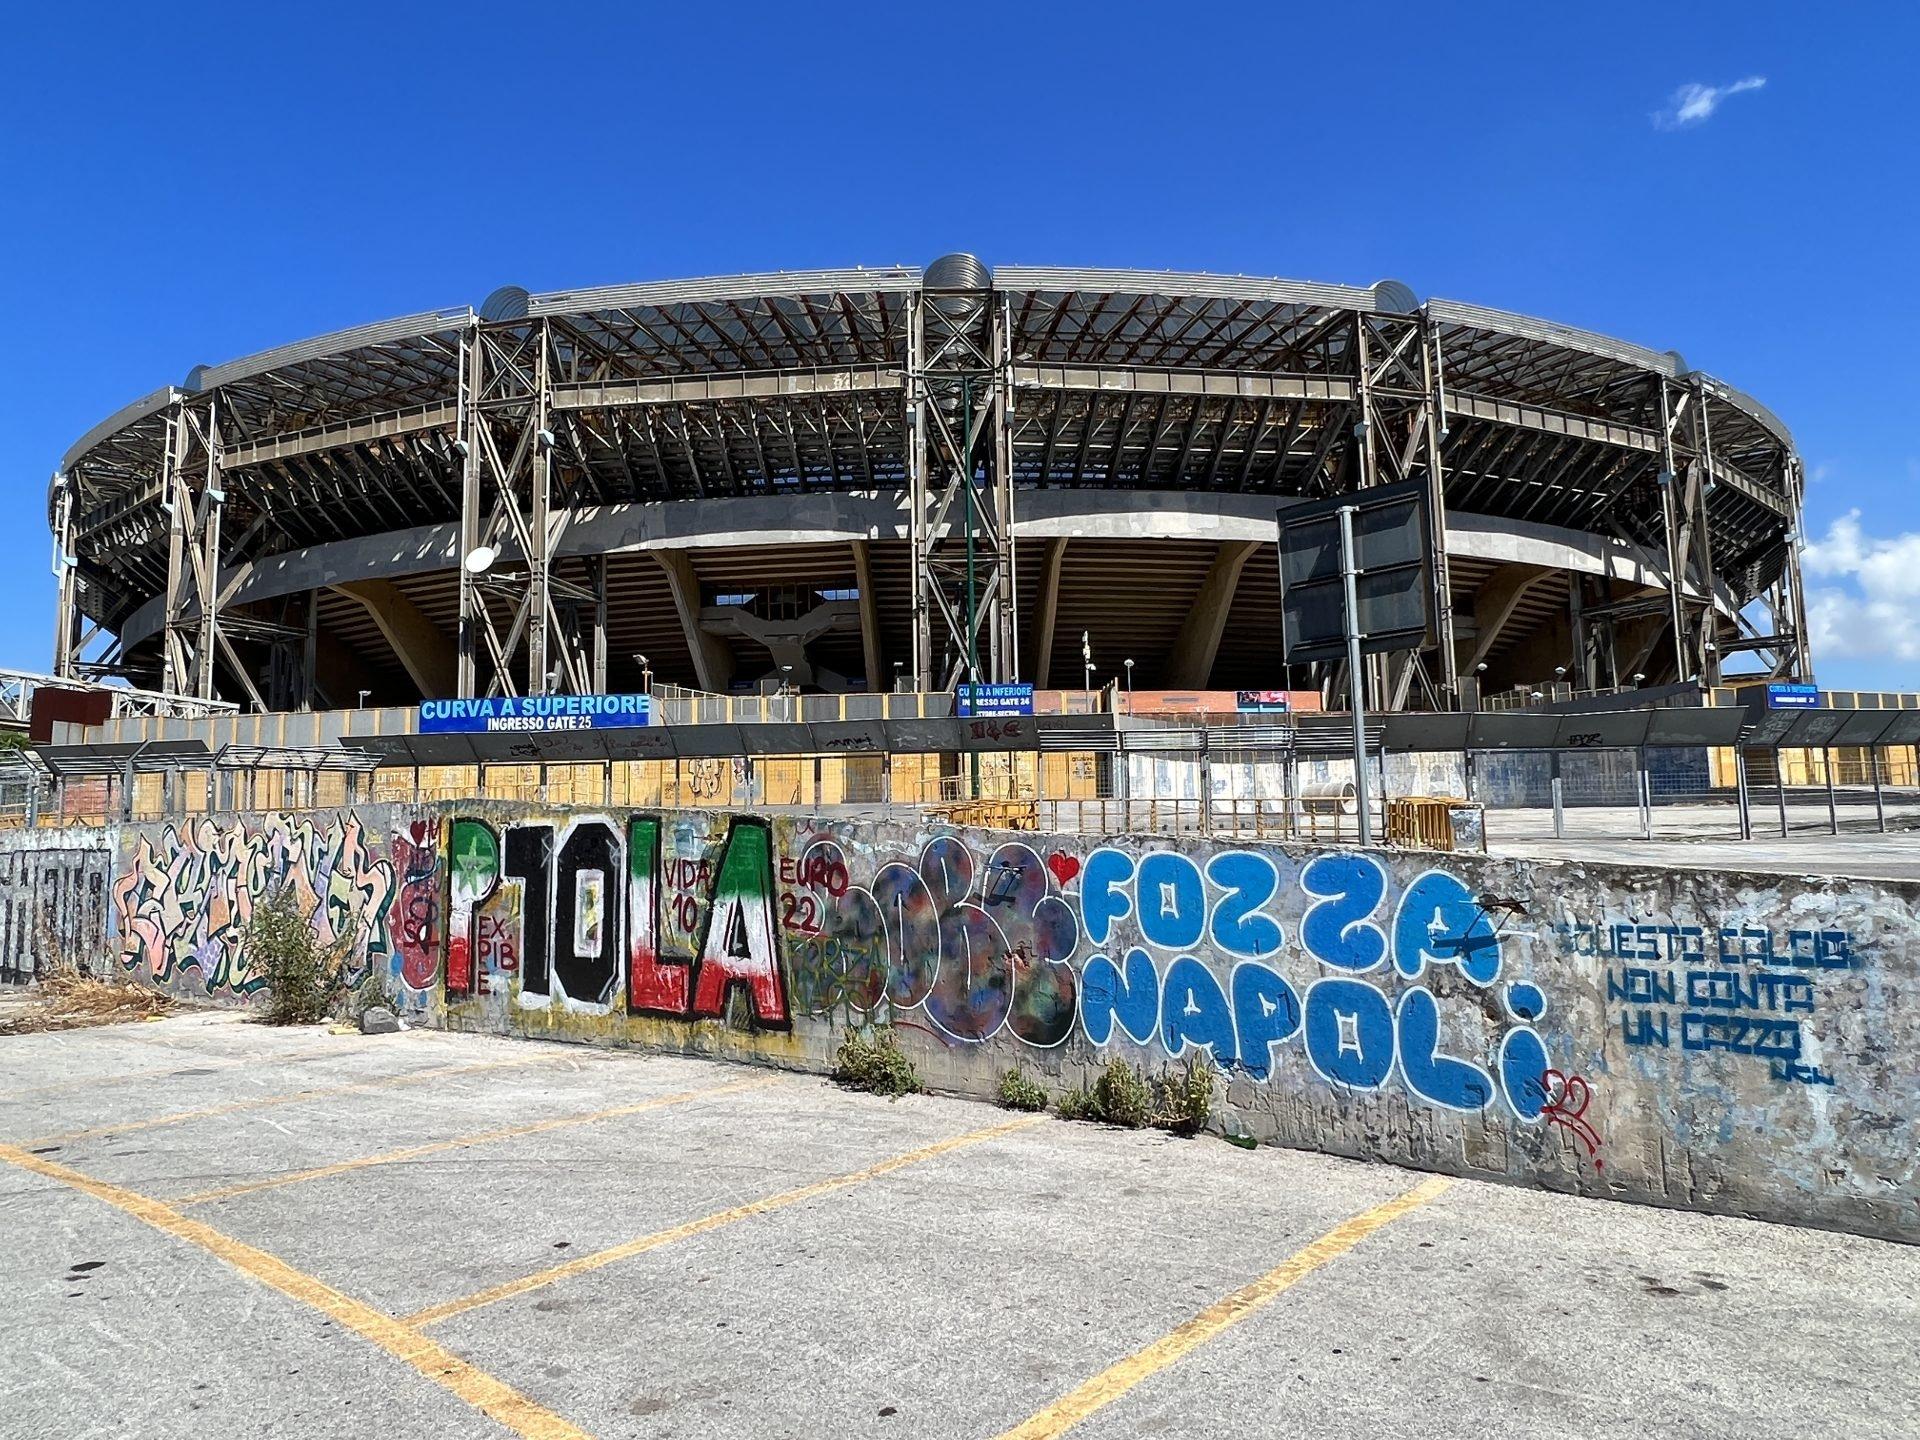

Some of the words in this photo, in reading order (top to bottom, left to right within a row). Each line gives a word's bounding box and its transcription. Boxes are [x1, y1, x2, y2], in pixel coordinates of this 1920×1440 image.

[421, 699, 494, 719] CURVA
[500, 698, 516, 716] A
[522, 695, 649, 717] SUPERIORE
[962, 698, 998, 707] INRESSO
[1000, 698, 1019, 706] GATE
[986, 687, 991, 696] A
[993, 687, 1032, 696] INFERIORE
[487, 716, 544, 731] INGRESSO
[546, 716, 576, 730] GATE
[578, 715, 592, 729] 25
[663, 858, 713, 893] VIDA
[781, 856, 849, 898] EURO
[672, 893, 698, 933] 10
[781, 892, 821, 933] 22
[478, 940, 518, 970] PIB
[1607, 967, 1676, 1004] NON
[1687, 970, 1815, 1013] CONTA
[1621, 1010, 1669, 1048] UN
